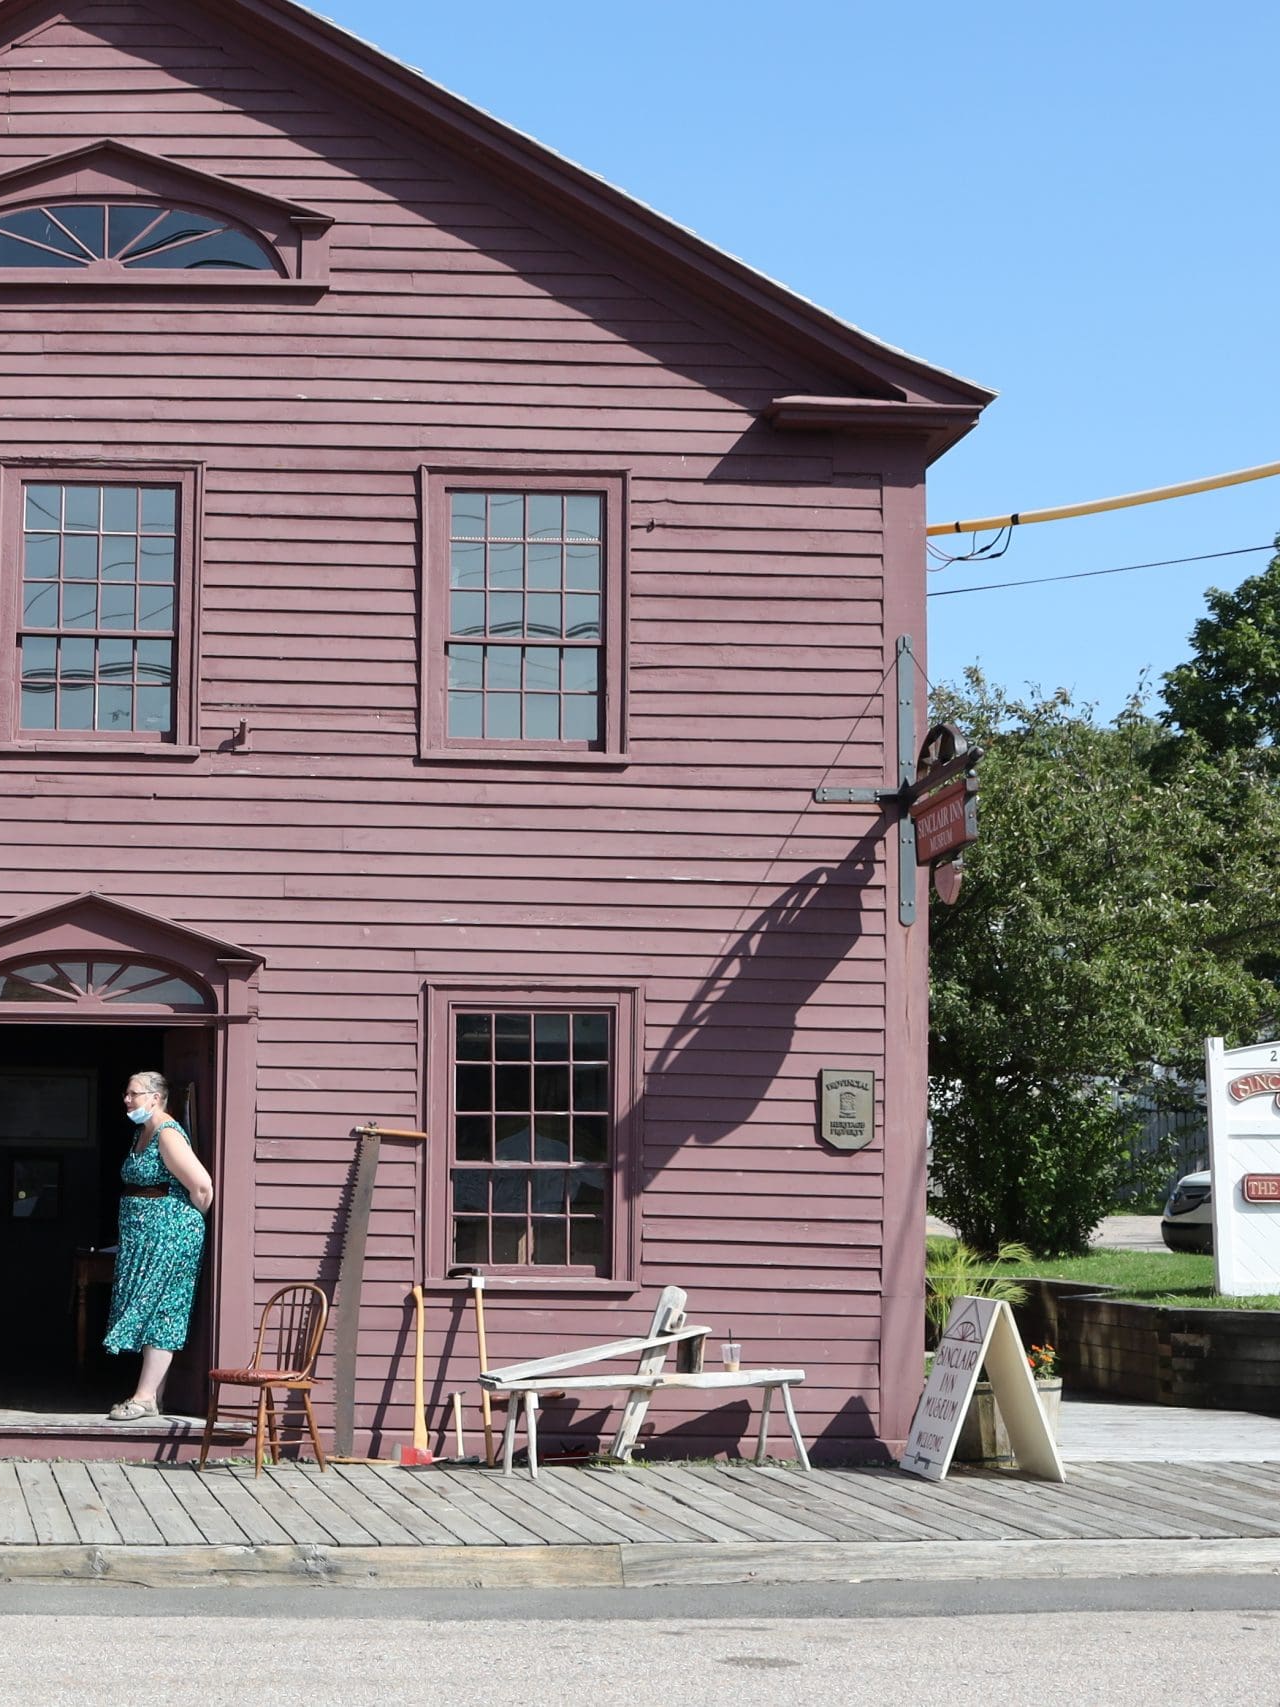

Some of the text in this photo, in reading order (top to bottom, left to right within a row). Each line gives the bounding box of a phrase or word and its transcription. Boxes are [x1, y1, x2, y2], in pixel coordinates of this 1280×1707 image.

[918, 797, 963, 840] SINCLAIR INN
[930, 827, 953, 852] MUSEUM
[825, 1079, 870, 1091] PROVINCIAL
[830, 1121, 865, 1129] HERITAGE
[830, 1129, 865, 1137] PROPERTY
[1248, 1181, 1278, 1195] THE
[936, 1345, 978, 1371] SINCLAIR
[939, 1372, 957, 1396] INN
[924, 1396, 958, 1422] MUSEUM
[916, 1430, 944, 1453] WELCOME
